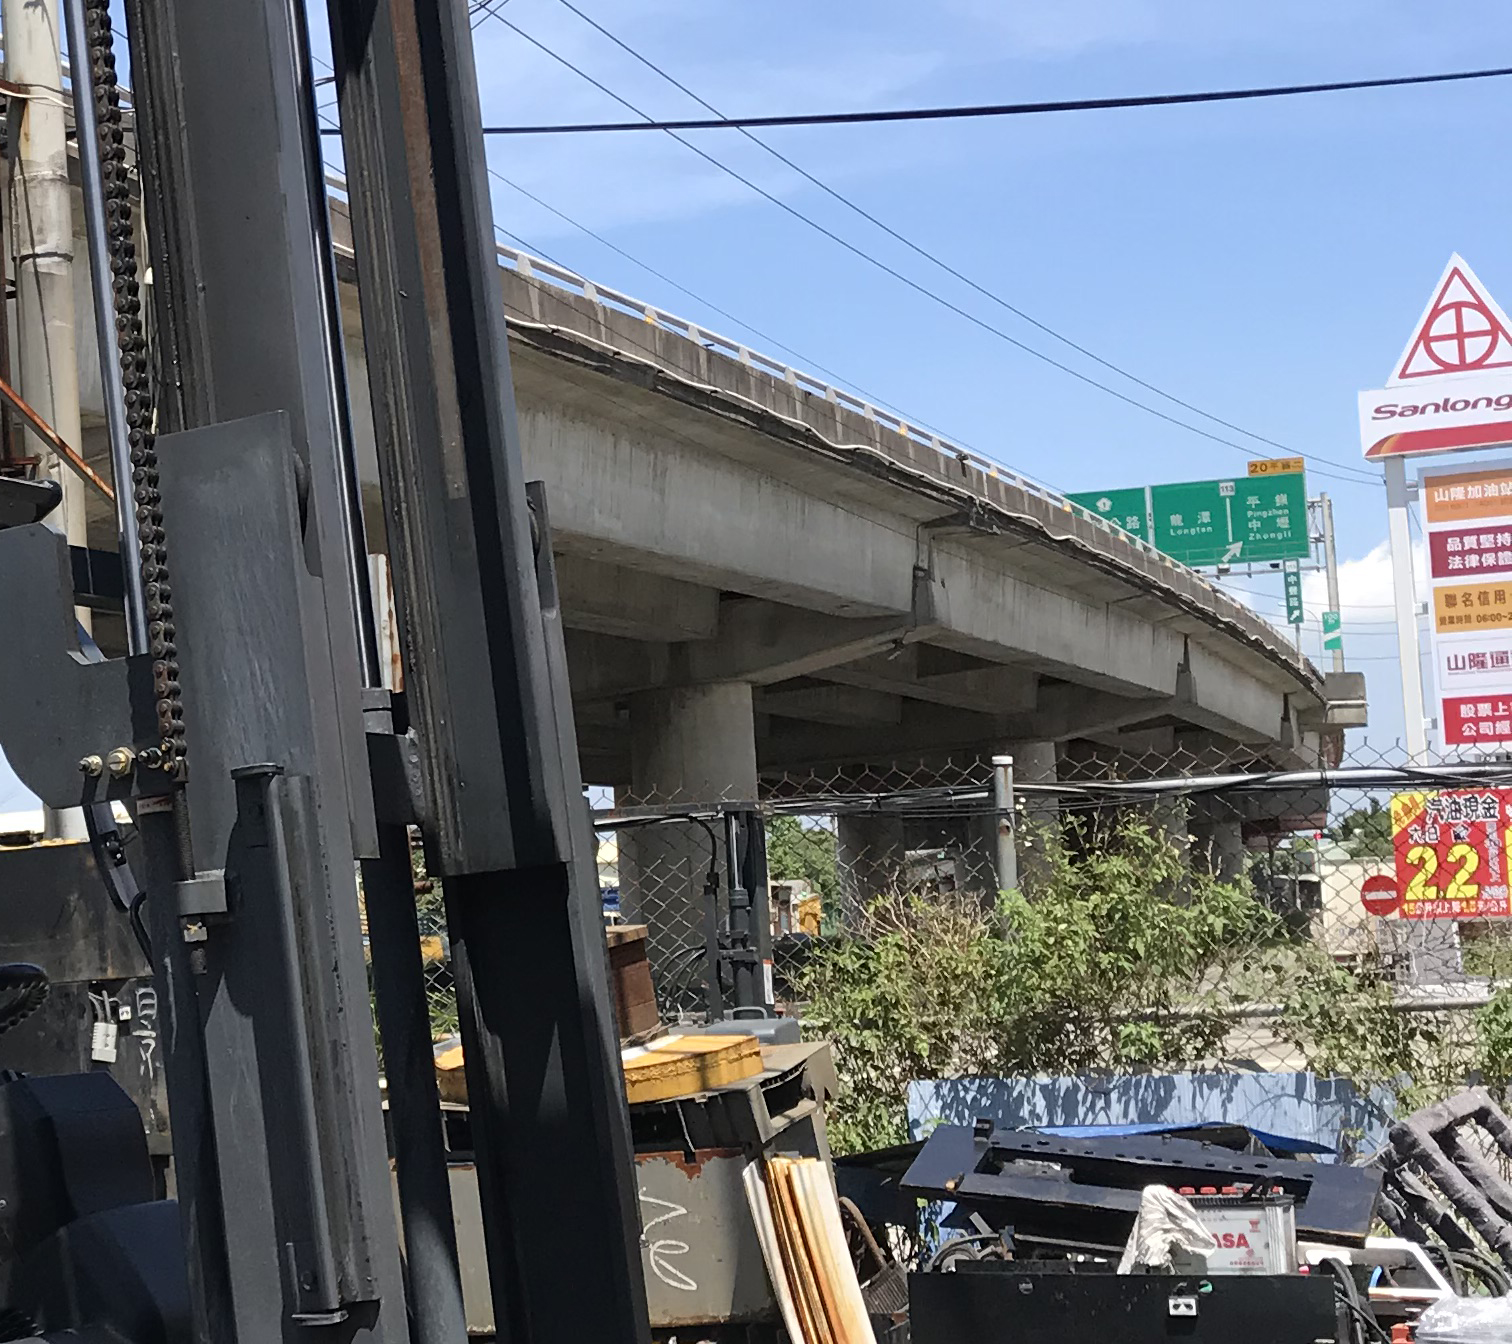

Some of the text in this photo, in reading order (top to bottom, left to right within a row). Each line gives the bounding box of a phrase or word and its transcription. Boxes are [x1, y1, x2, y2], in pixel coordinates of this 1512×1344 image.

[1371, 394, 1512, 421] Sanlong
[1220, 485, 1234, 493] 113
[1447, 532, 1511, 552] 品質堅持
[1444, 589, 1512, 609] 聯名信用
[1447, 650, 1512, 671] 山隆通
[1460, 701, 1512, 718] 股票上
[1461, 720, 1512, 736] 公司經
